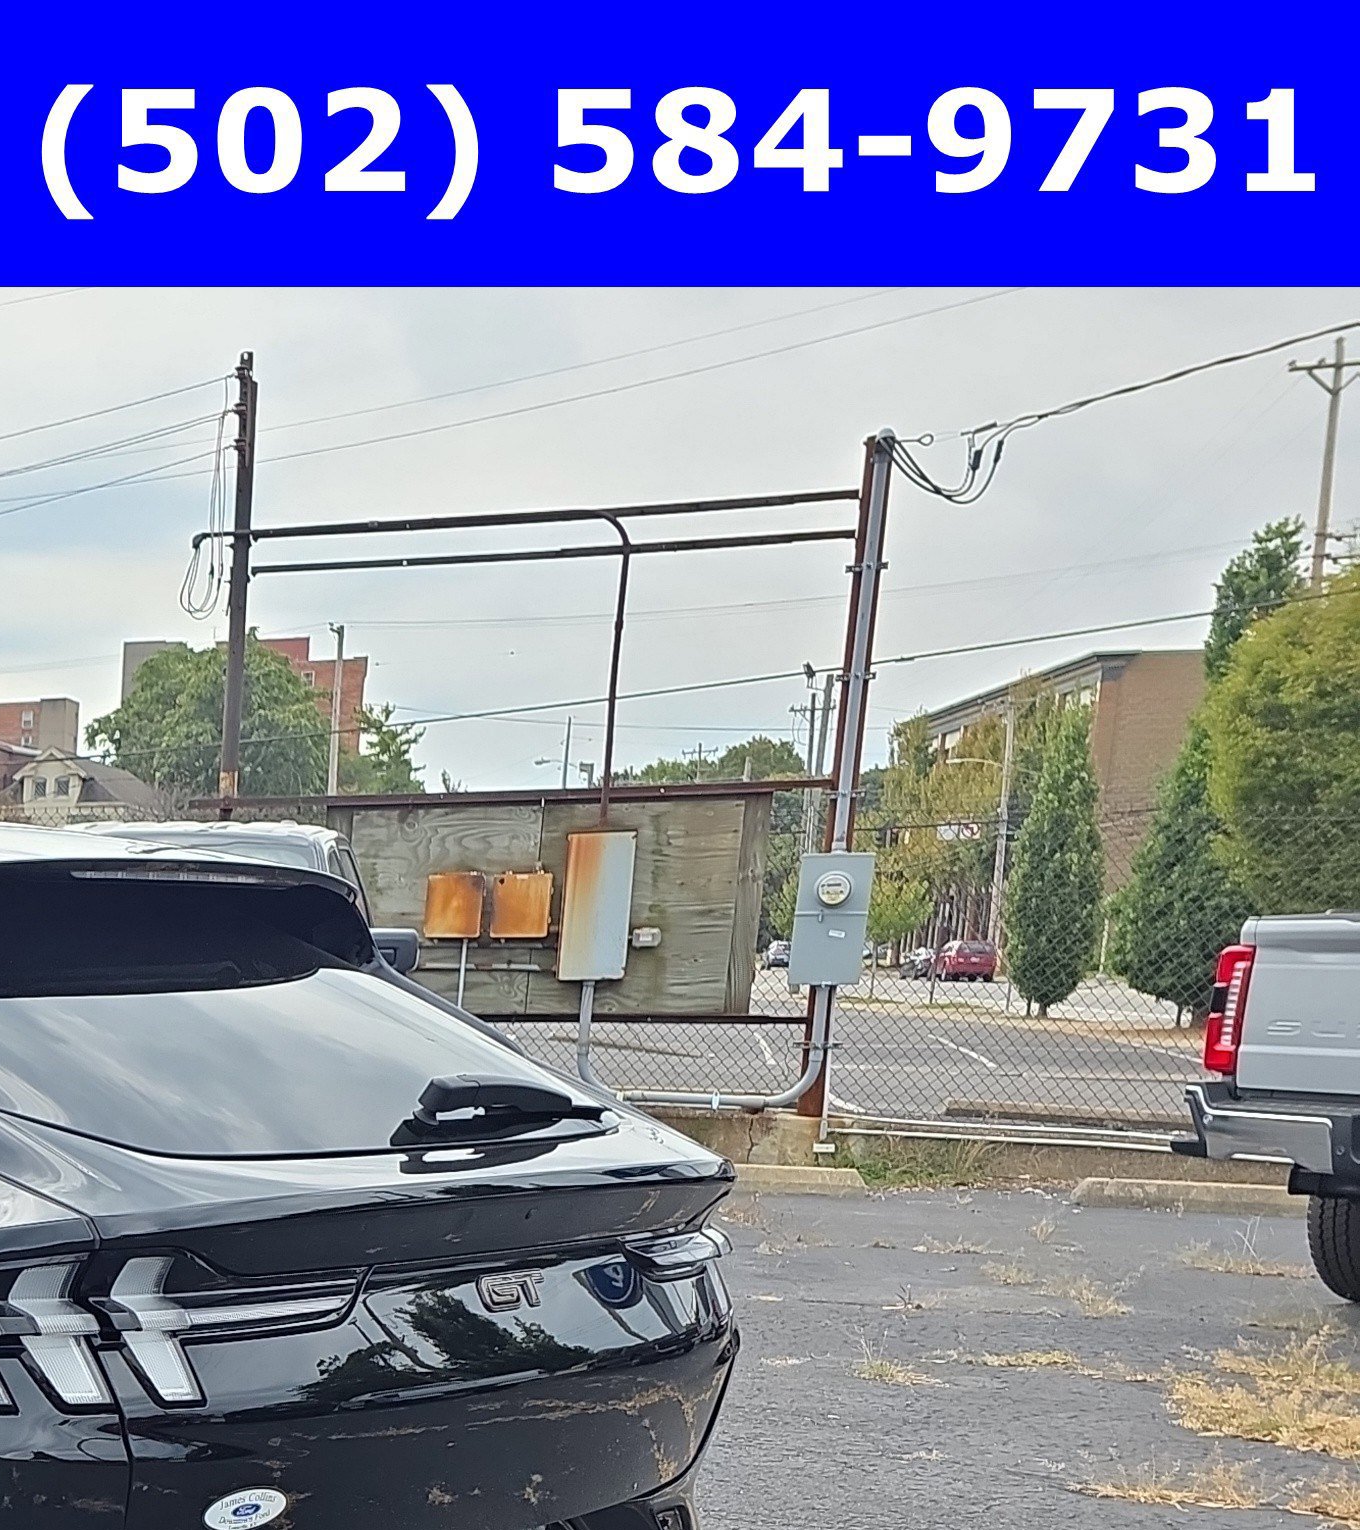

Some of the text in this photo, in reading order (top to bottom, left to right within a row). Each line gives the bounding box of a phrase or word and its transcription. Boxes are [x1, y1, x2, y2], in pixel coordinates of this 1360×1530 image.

[476, 1268, 544, 1312] GT
[220, 1491, 277, 1510] James Collins
